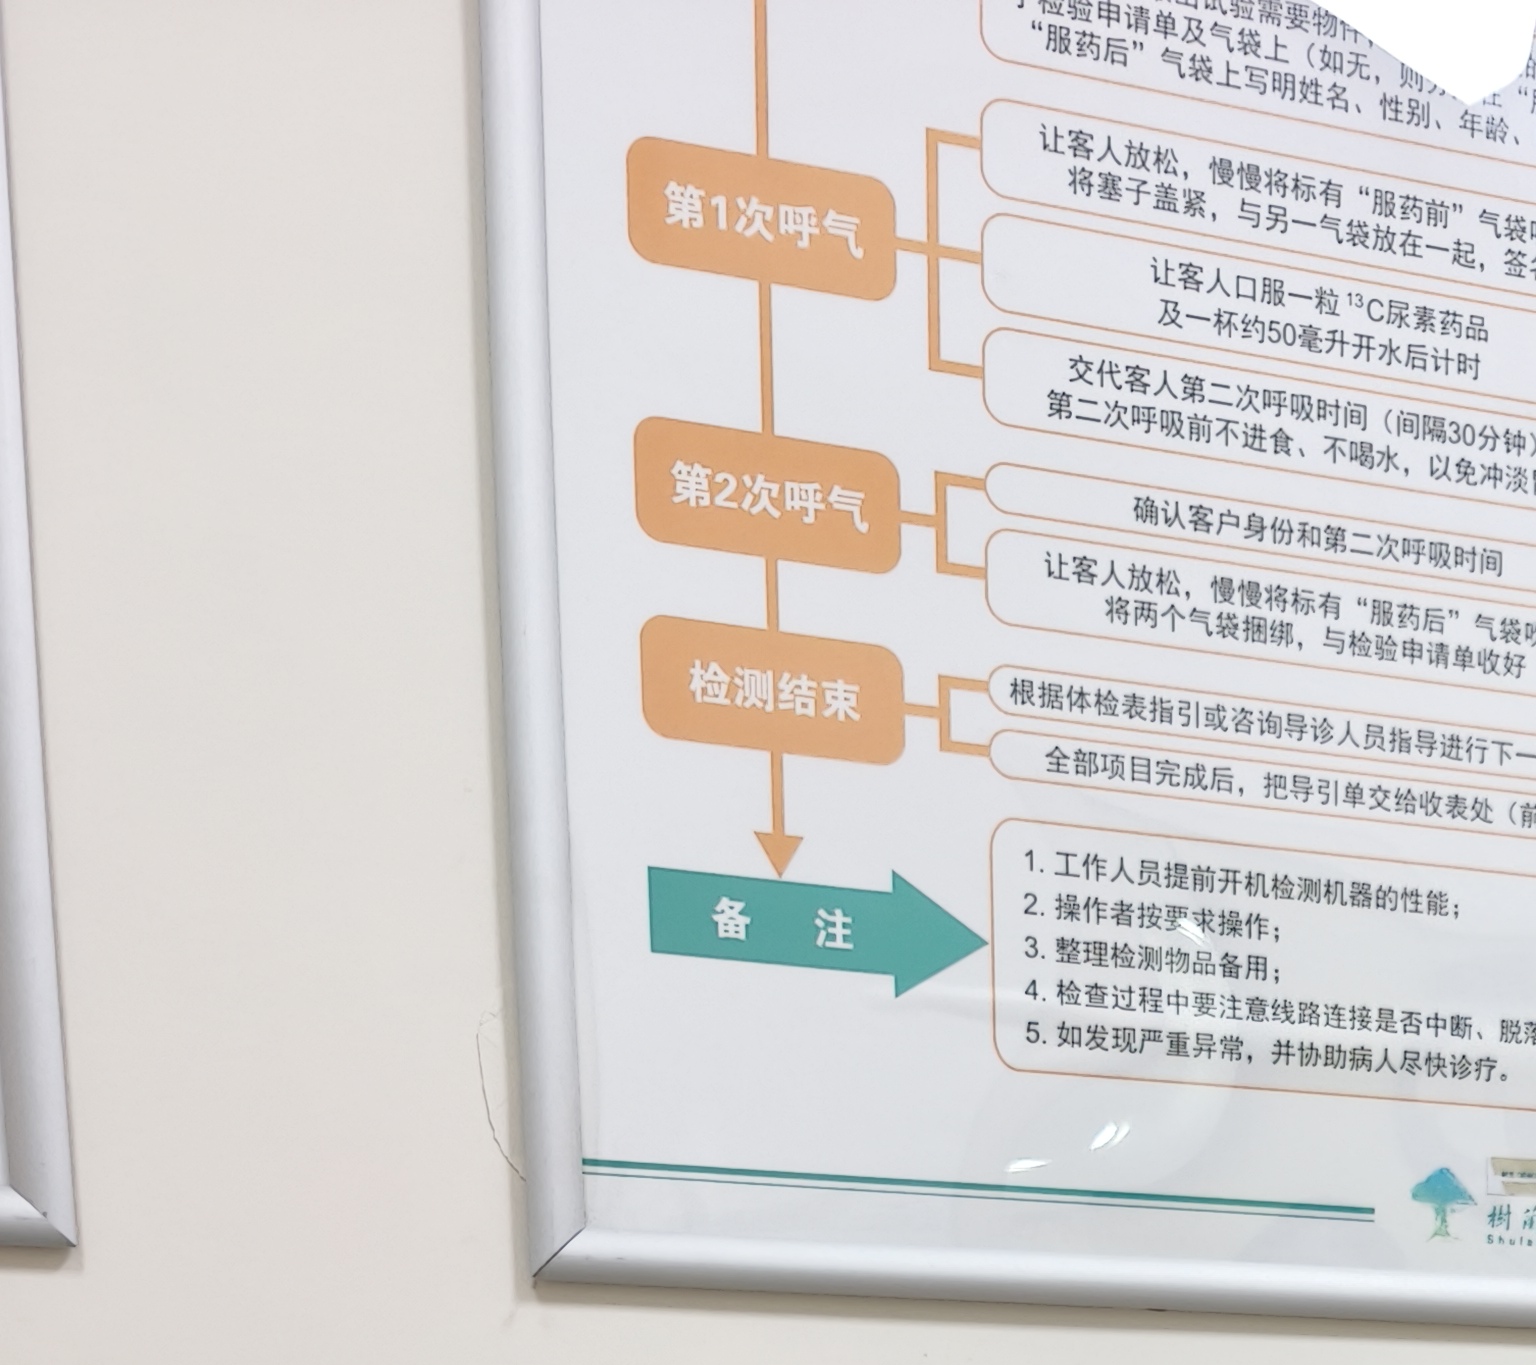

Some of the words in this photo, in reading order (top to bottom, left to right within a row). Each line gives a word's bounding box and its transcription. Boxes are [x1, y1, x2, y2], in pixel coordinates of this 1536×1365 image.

[663, 181, 864, 260] 第1次呼气
[1157, 301, 1480, 381] 及一杯约50毫升开水后计时
[670, 460, 869, 534] 第2次呼气
[1134, 497, 1503, 577] 确认客户身份和第二次呼吸时间
[1105, 596, 1526, 678] 将两个气袋捆绑，与检验申请单收好
[689, 659, 861, 721] 检测结束
